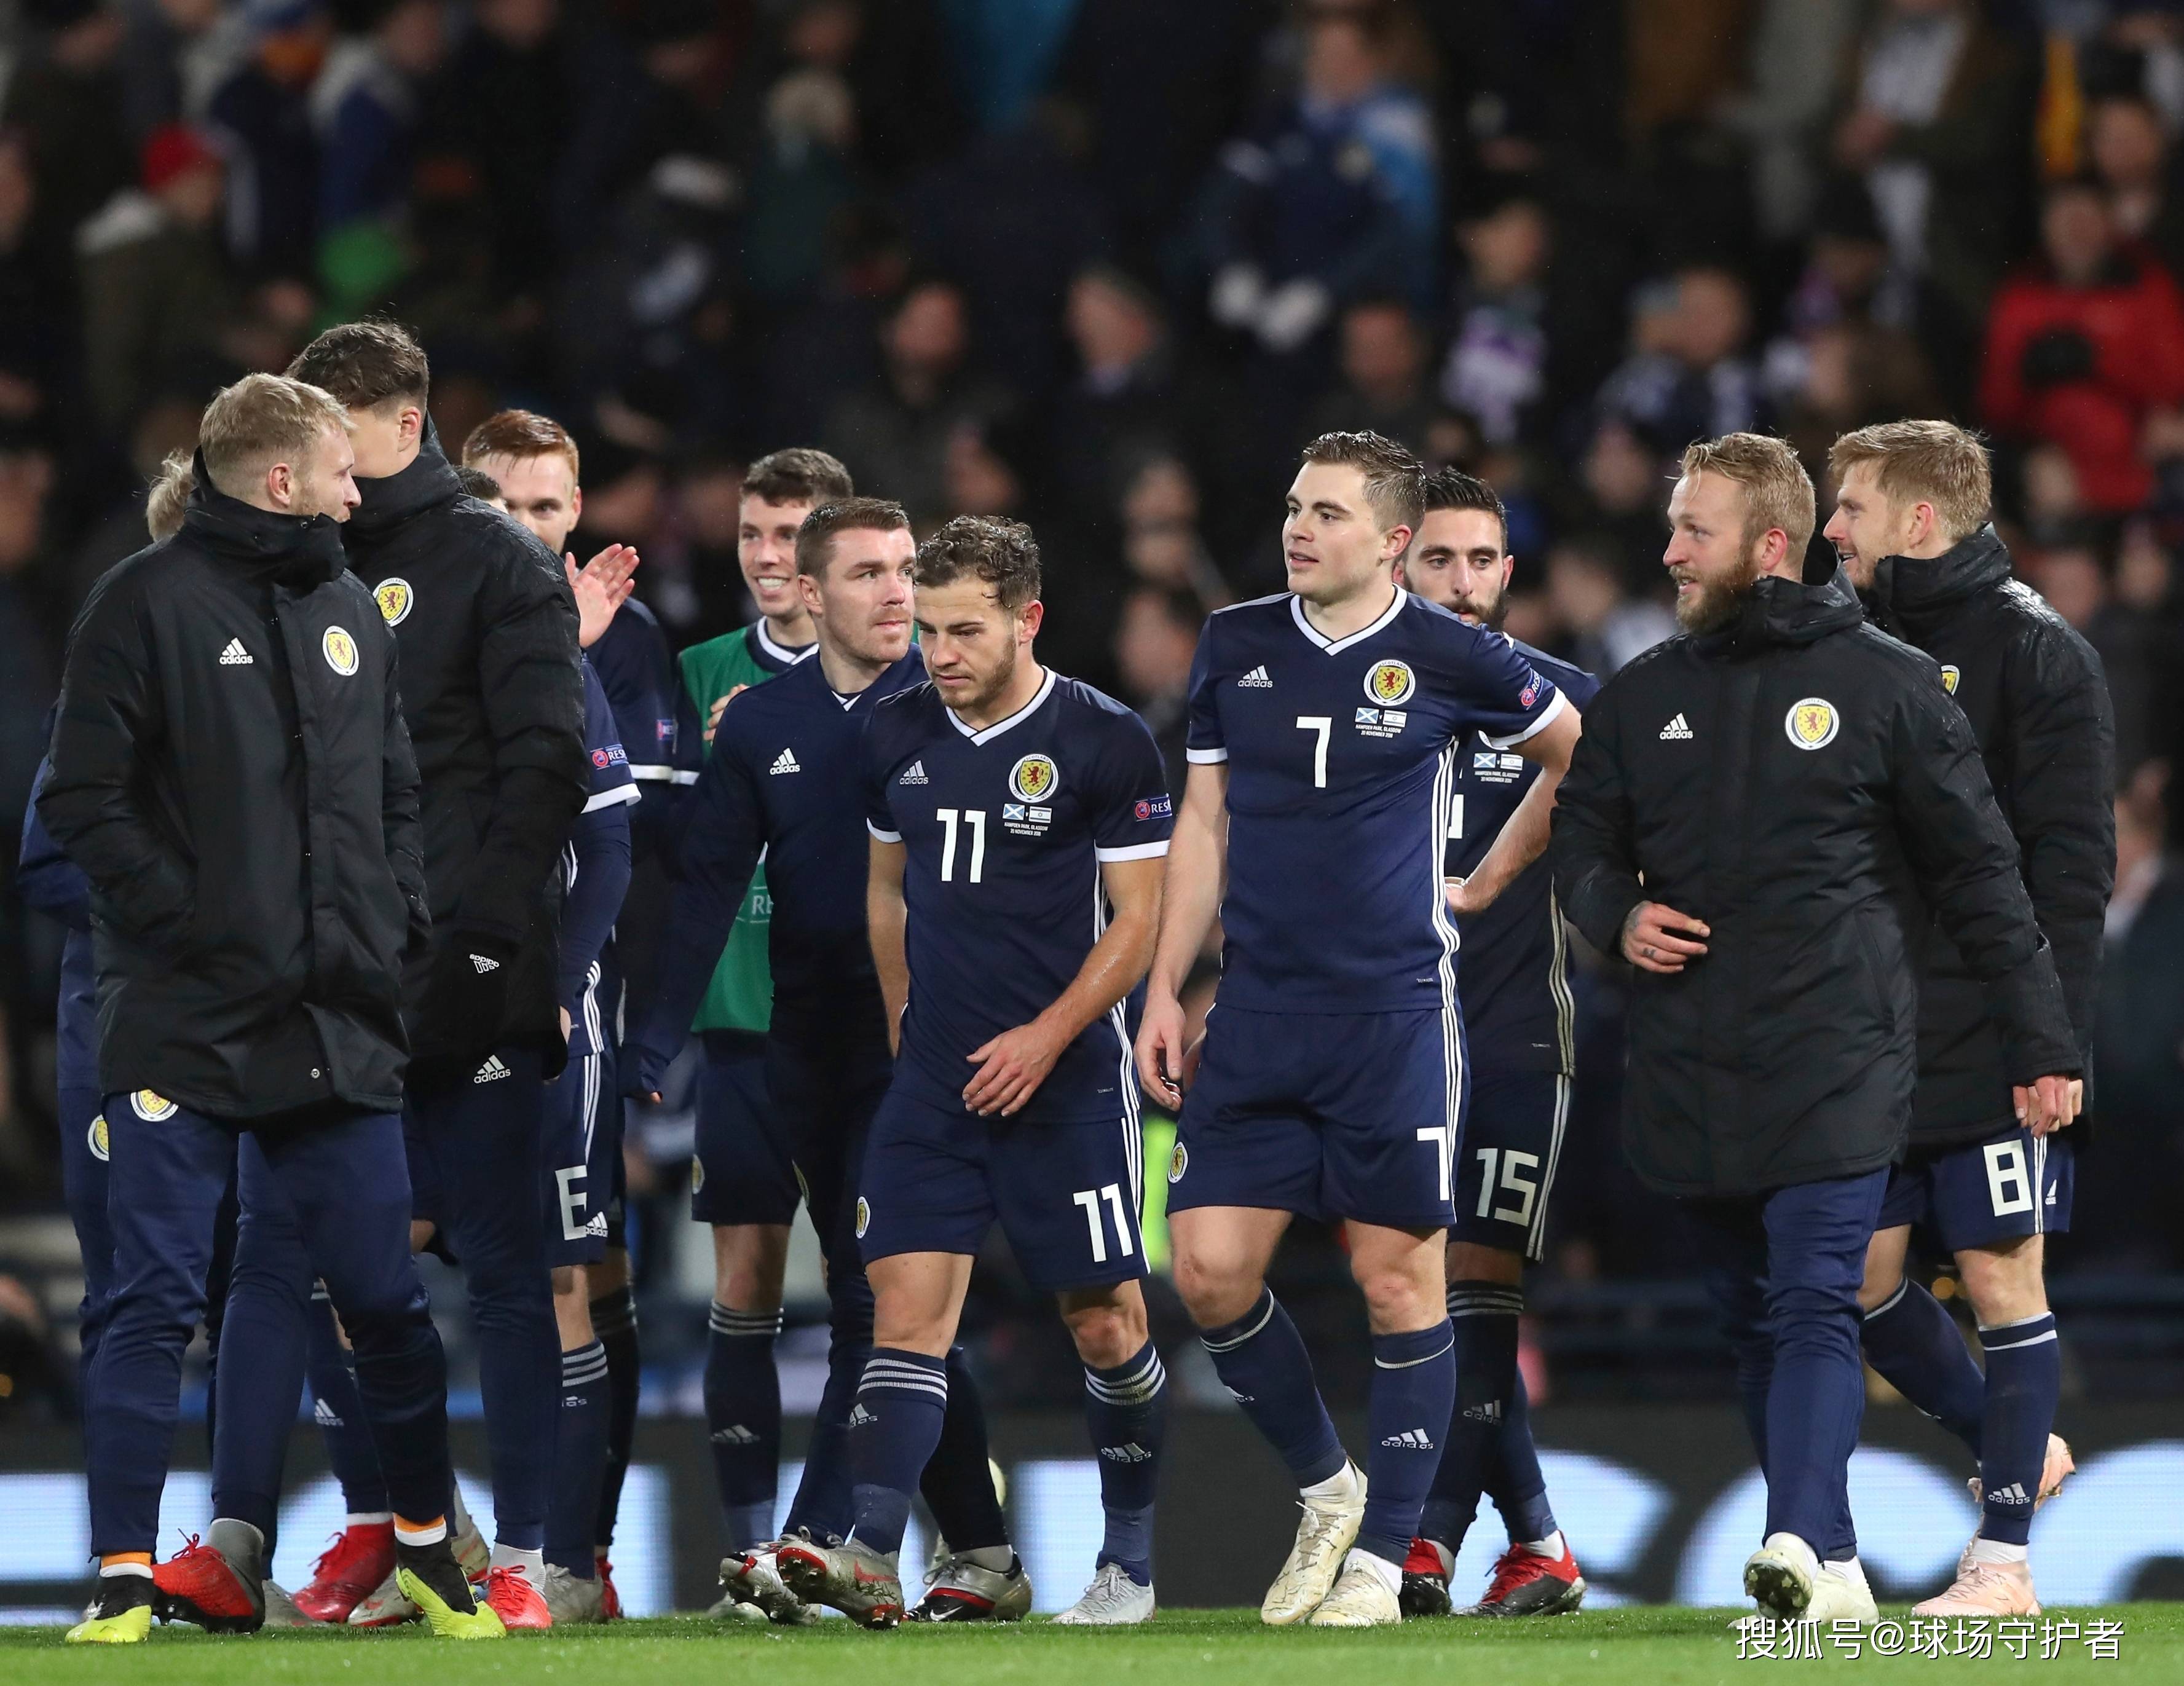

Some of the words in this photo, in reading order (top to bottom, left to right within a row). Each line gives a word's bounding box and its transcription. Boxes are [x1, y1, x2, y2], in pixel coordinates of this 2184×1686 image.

[219, 655, 253, 664] adidas
[1238, 679, 1272, 688] adidas
[1660, 730, 1693, 739] adidas
[1296, 716, 1333, 788] 7
[770, 764, 800, 775] adidas
[899, 776, 929, 785] adidas
[936, 808, 986, 883] 11
[469, 954, 500, 967] adidas
[473, 1068, 511, 1084] adidas
[1416, 1126, 1450, 1200] 7
[1983, 1138, 2033, 1217] 8
[1476, 1148, 1539, 1227] 15
[1073, 1183, 1133, 1263] 11
[585, 1226, 609, 1238] adida
[1381, 1440, 1433, 1449] adidas
[1101, 1448, 1152, 1462] adidas
[1988, 1494, 2030, 1505] adidas
